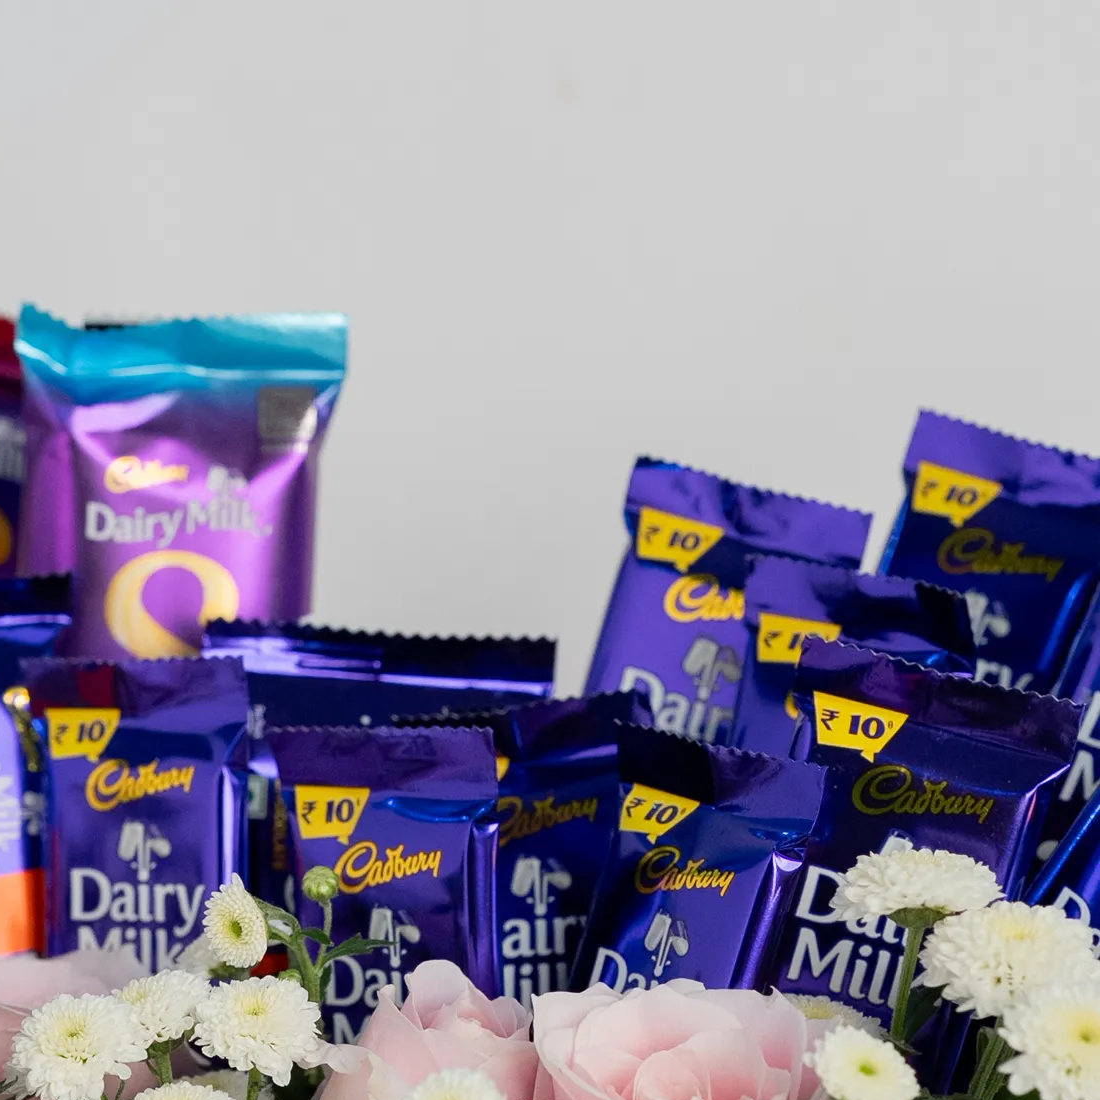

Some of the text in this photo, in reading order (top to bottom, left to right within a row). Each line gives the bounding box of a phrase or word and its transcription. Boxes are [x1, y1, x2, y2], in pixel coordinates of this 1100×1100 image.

[946, 486, 978, 506] 10
[85, 501, 184, 549] Dairy
[668, 531, 700, 551] 10
[619, 665, 733, 743] Dair
[849, 714, 885, 739] 10
[77, 721, 106, 742] 10
[86, 758, 196, 811] Cadbury
[852, 764, 995, 823] Cadbury
[326, 799, 354, 823] 10
[643, 803, 679, 824] 10
[334, 840, 442, 893] Cadbury
[635, 845, 736, 897] Cadbury
[70, 867, 205, 938] Dairy
[502, 916, 587, 960] air
[324, 955, 404, 1011] Dai
[787, 927, 903, 1010] Mil
